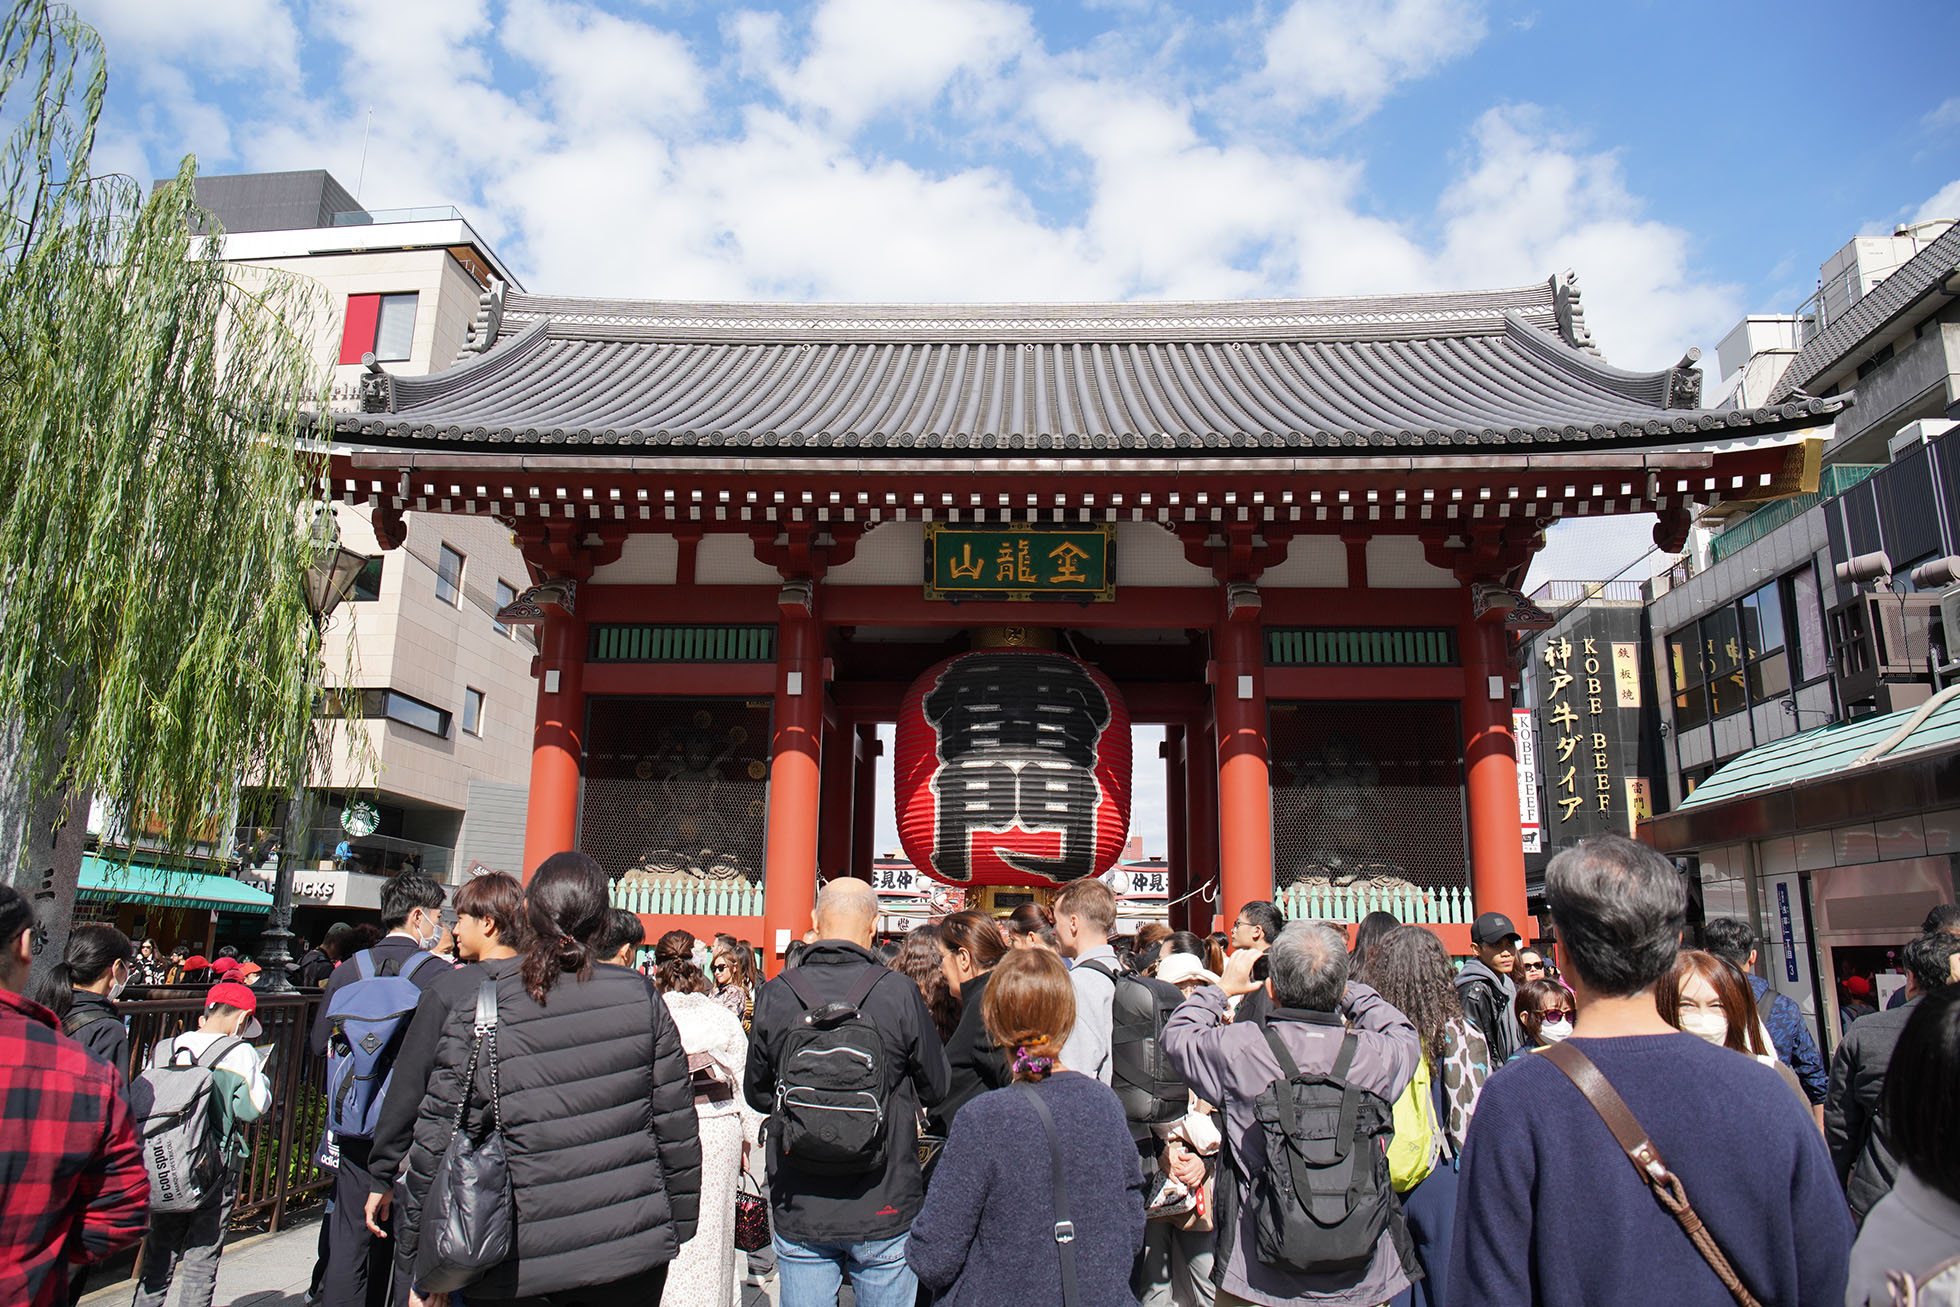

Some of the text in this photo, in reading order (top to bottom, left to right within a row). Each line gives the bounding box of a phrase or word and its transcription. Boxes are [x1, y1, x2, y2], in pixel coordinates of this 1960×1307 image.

[1520, 716, 1532, 766] KOBE
[1544, 637, 1583, 822] 神戸牛ダイア
[1583, 638, 1611, 812] KOBE BEEF
[922, 652, 1113, 883] 雷門
[1524, 772, 1536, 821] BEEF
[1132, 872, 1168, 892] 仲見
[158, 1170, 171, 1191] coq
[320, 1153, 340, 1168] adid
[162, 1192, 175, 1202] le
